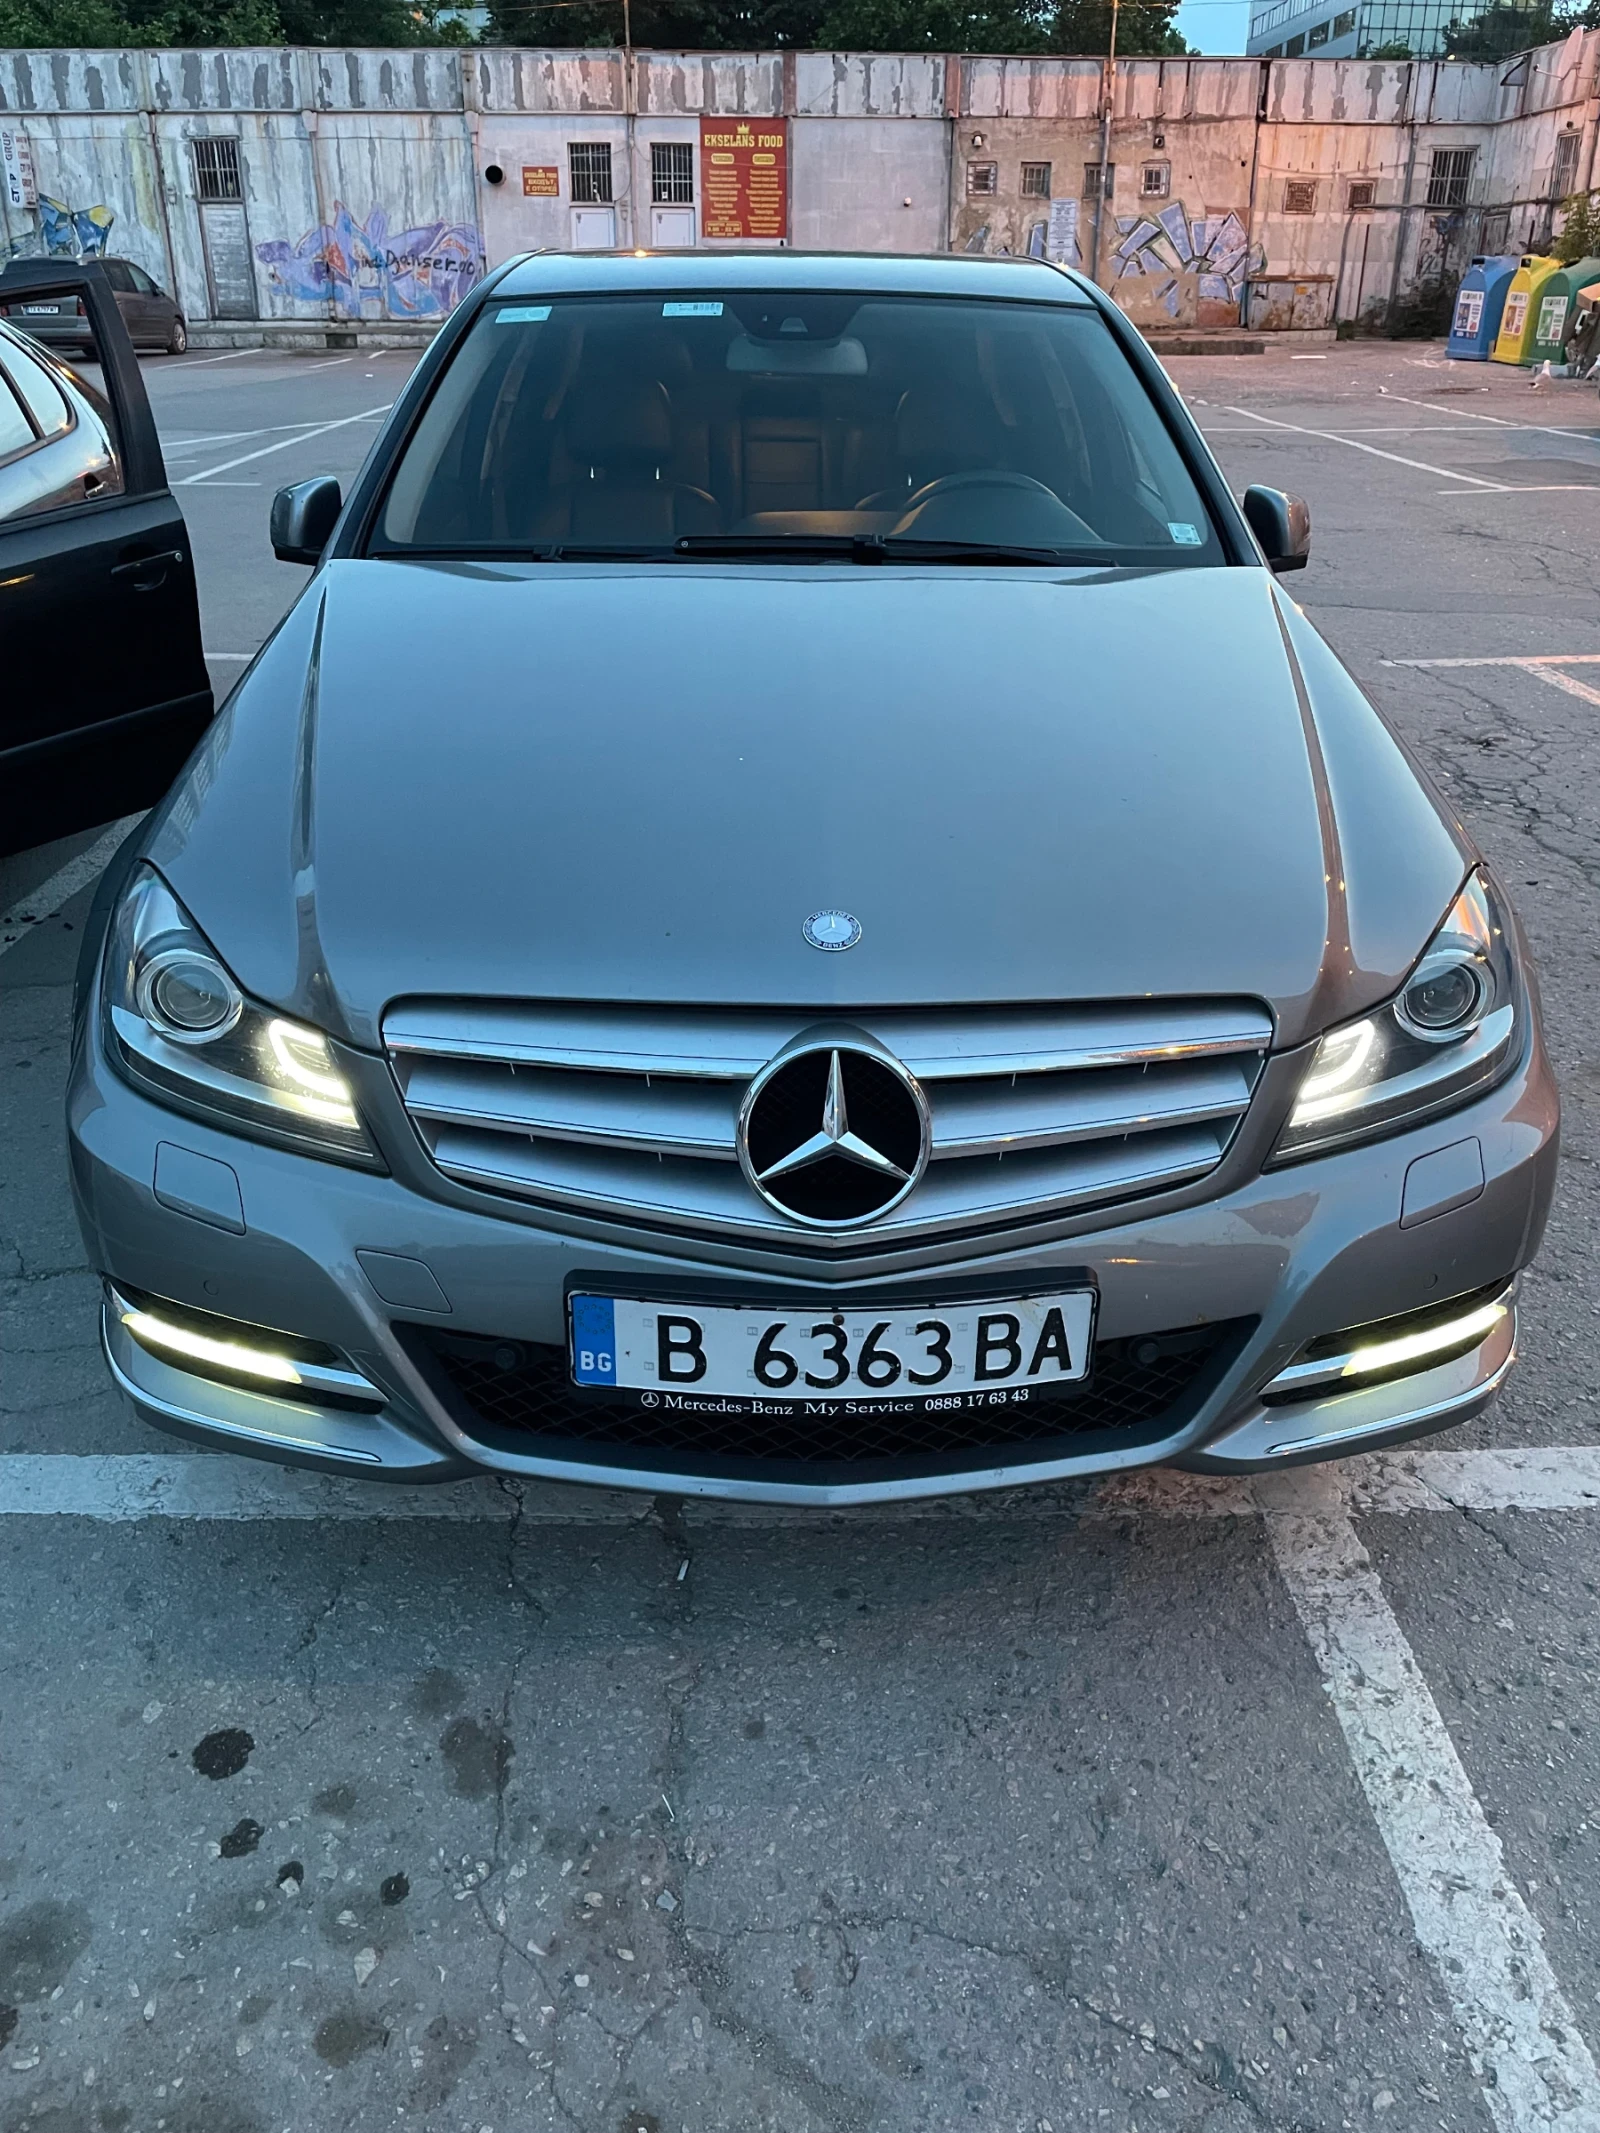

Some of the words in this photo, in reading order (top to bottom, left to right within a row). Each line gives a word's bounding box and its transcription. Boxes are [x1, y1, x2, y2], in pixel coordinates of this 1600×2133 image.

[2, 132, 13, 161] GRUP
[704, 134, 755, 148] EKSELANS
[758, 135, 783, 148] FOOD
[580, 1351, 612, 1372] BG
[657, 1313, 708, 1384] B
[753, 1319, 953, 1389] 6363
[974, 1307, 1073, 1382] BA
[664, 1395, 794, 1415] Mercedes-Benz
[804, 1401, 839, 1416] My
[845, 1401, 915, 1414] Service
[925, 1397, 962, 1411] 0888
[967, 1393, 984, 1408] 17
[988, 1391, 1007, 1404] 63
[1011, 1389, 1029, 1402] 43
